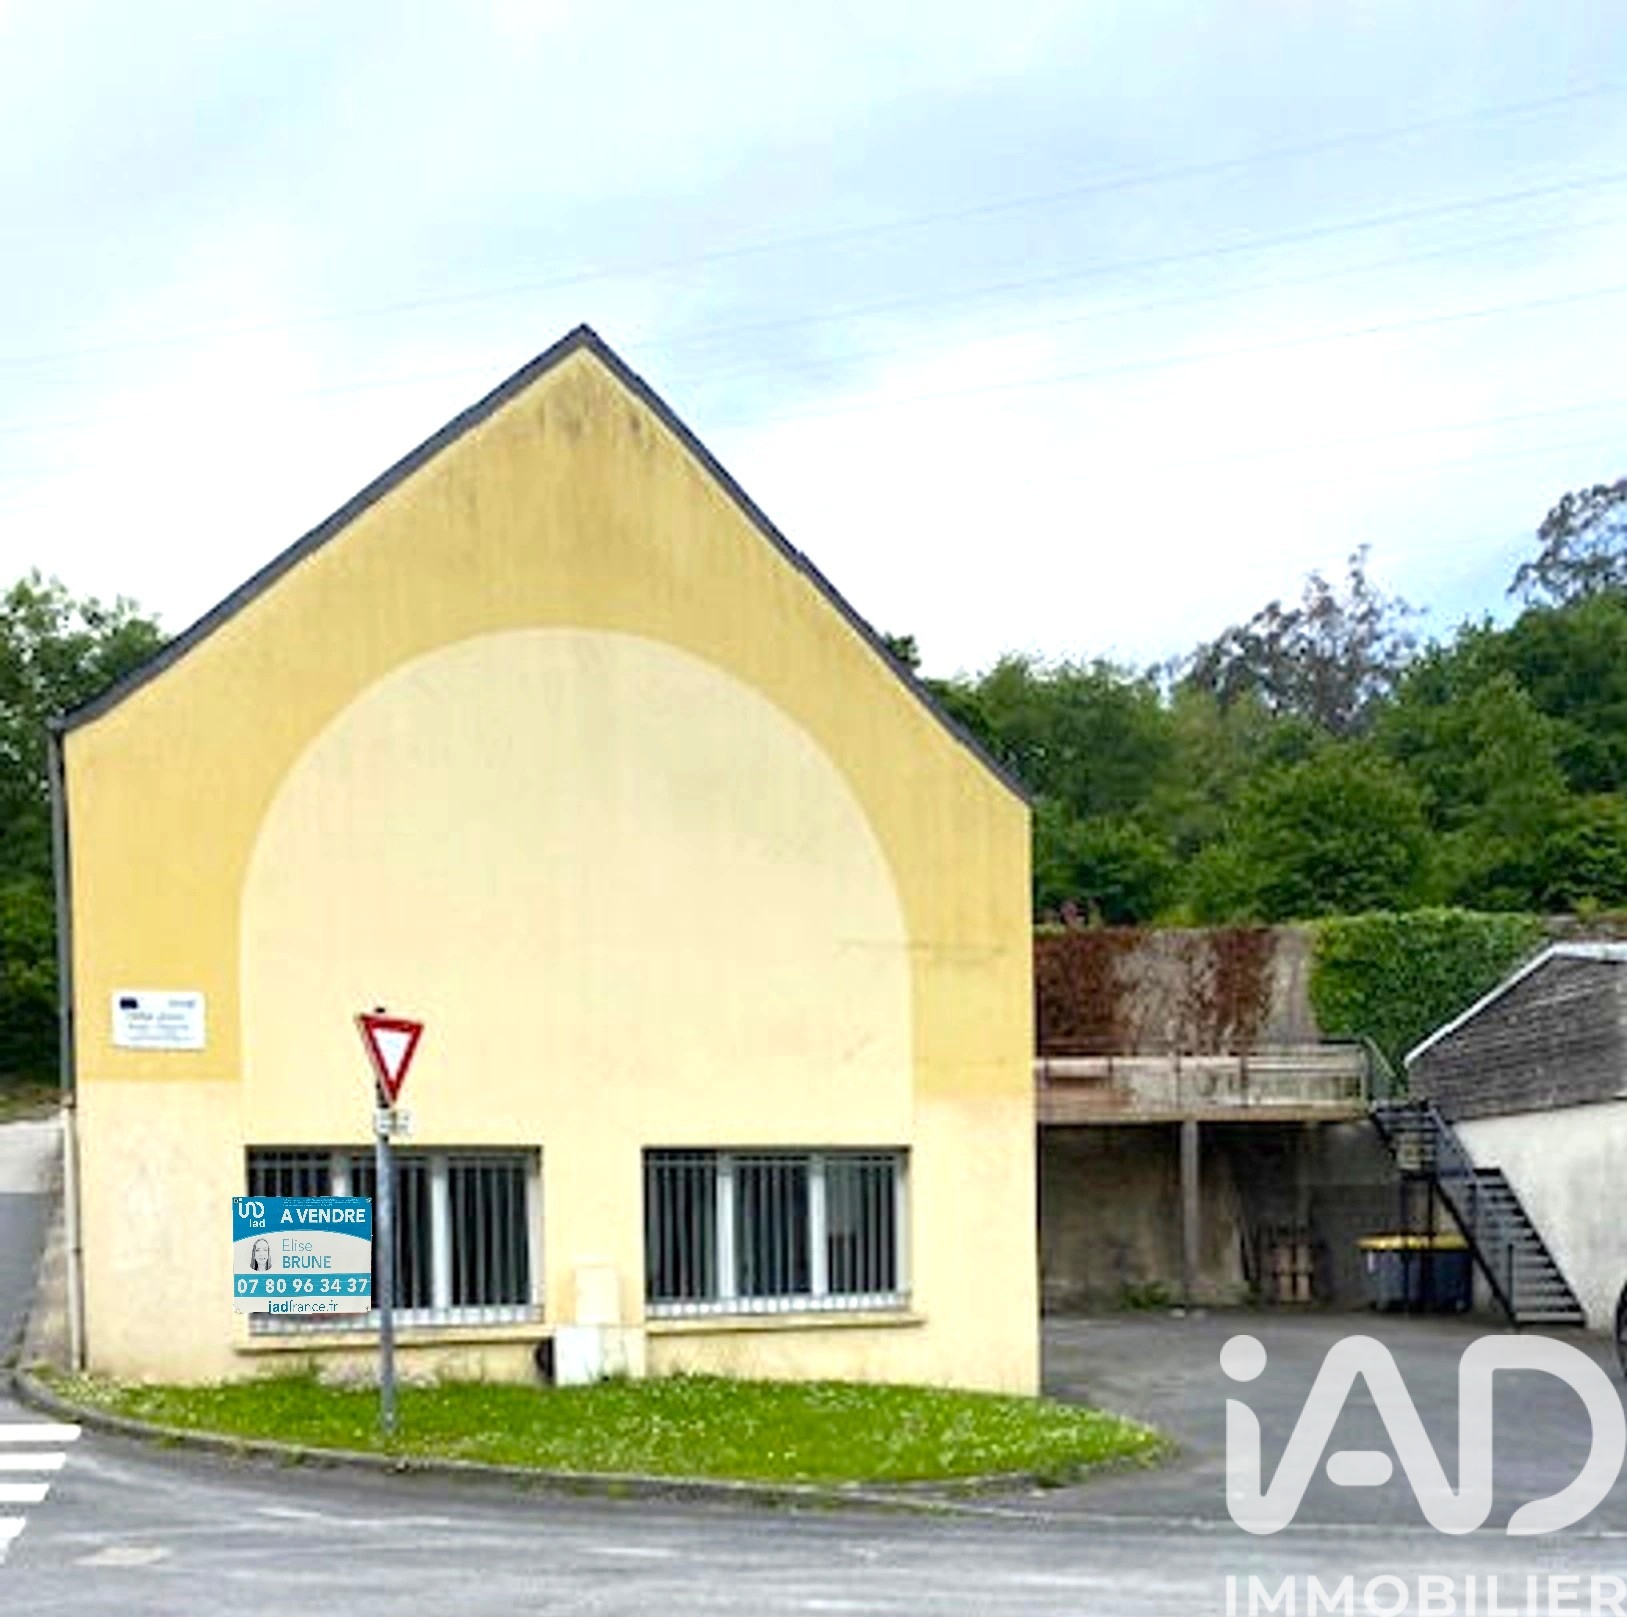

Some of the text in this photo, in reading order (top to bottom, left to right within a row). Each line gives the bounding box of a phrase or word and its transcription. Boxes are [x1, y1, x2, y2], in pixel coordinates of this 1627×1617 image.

[280, 1208, 366, 1223] A VENDRE
[282, 1238, 313, 1252] Elise
[282, 1255, 332, 1269] BRUNE
[237, 1277, 368, 1294] 07 80 96 34 37
